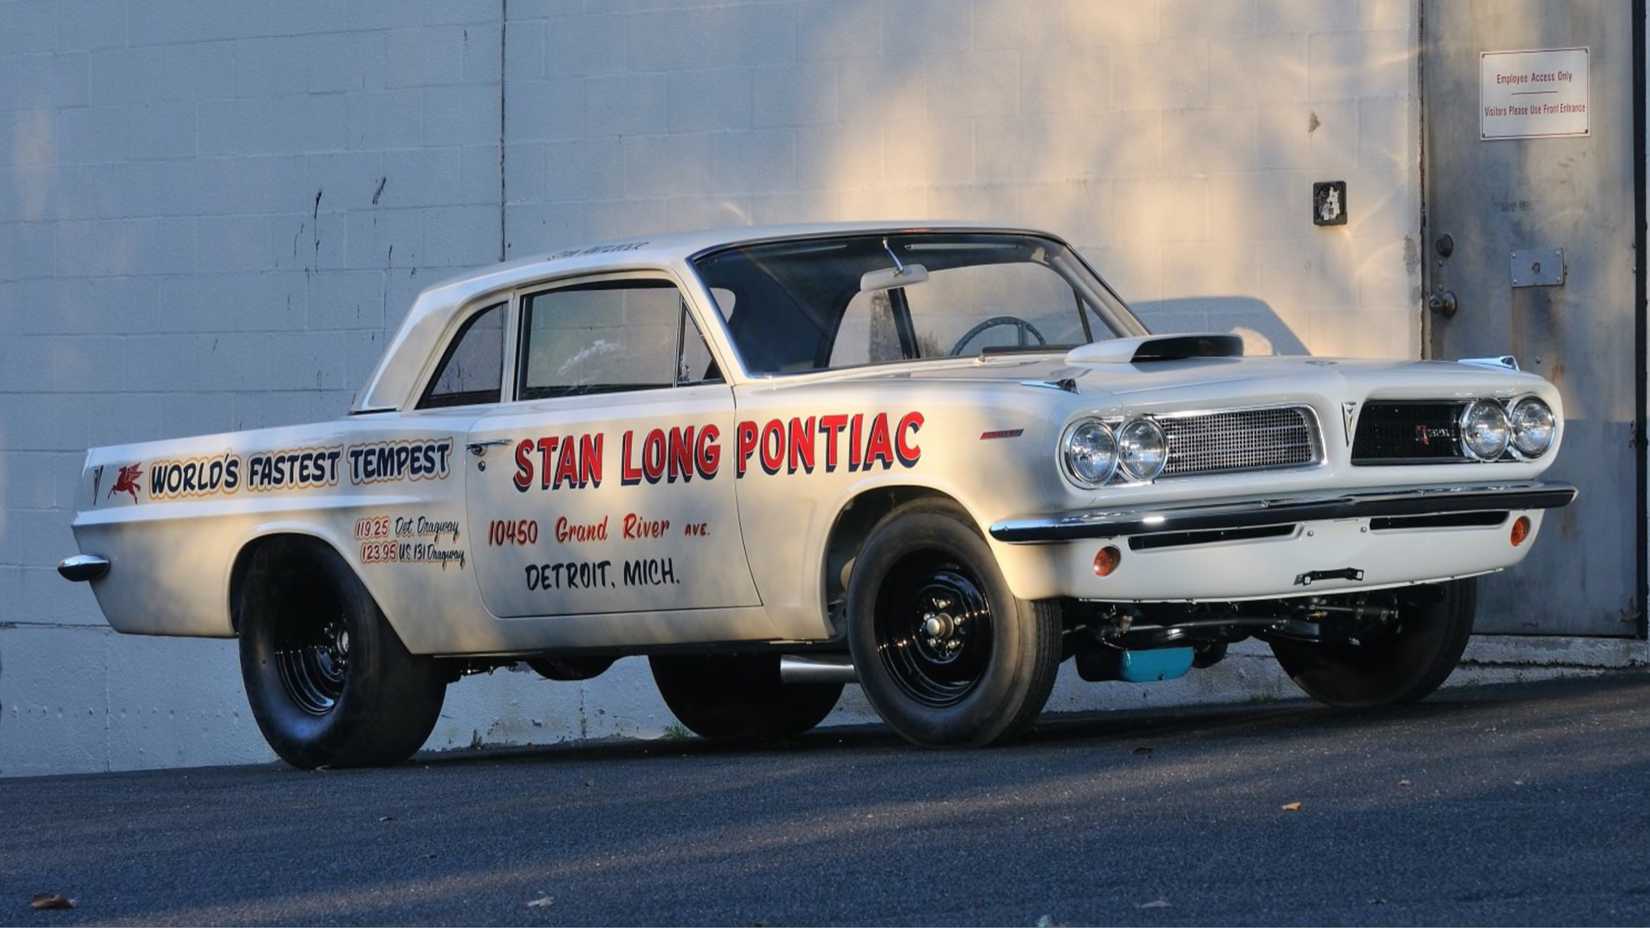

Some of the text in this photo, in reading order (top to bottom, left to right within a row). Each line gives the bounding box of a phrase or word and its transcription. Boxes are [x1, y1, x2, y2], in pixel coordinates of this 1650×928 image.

[1496, 71, 1572, 85] Employee Access Only
[1485, 103, 1585, 117] Visitors Please Use Front Entrance
[513, 411, 925, 493] STAN LONG PONTIAC
[151, 443, 450, 495] WORLD'S FASTEST TEMPEST
[417, 516, 459, 542] Dragway
[488, 513, 710, 546] 10450 Grand River AVE.
[413, 543, 426, 560] 131
[427, 544, 465, 569] Dragway
[525, 557, 681, 591] DETROIT, MICH.
